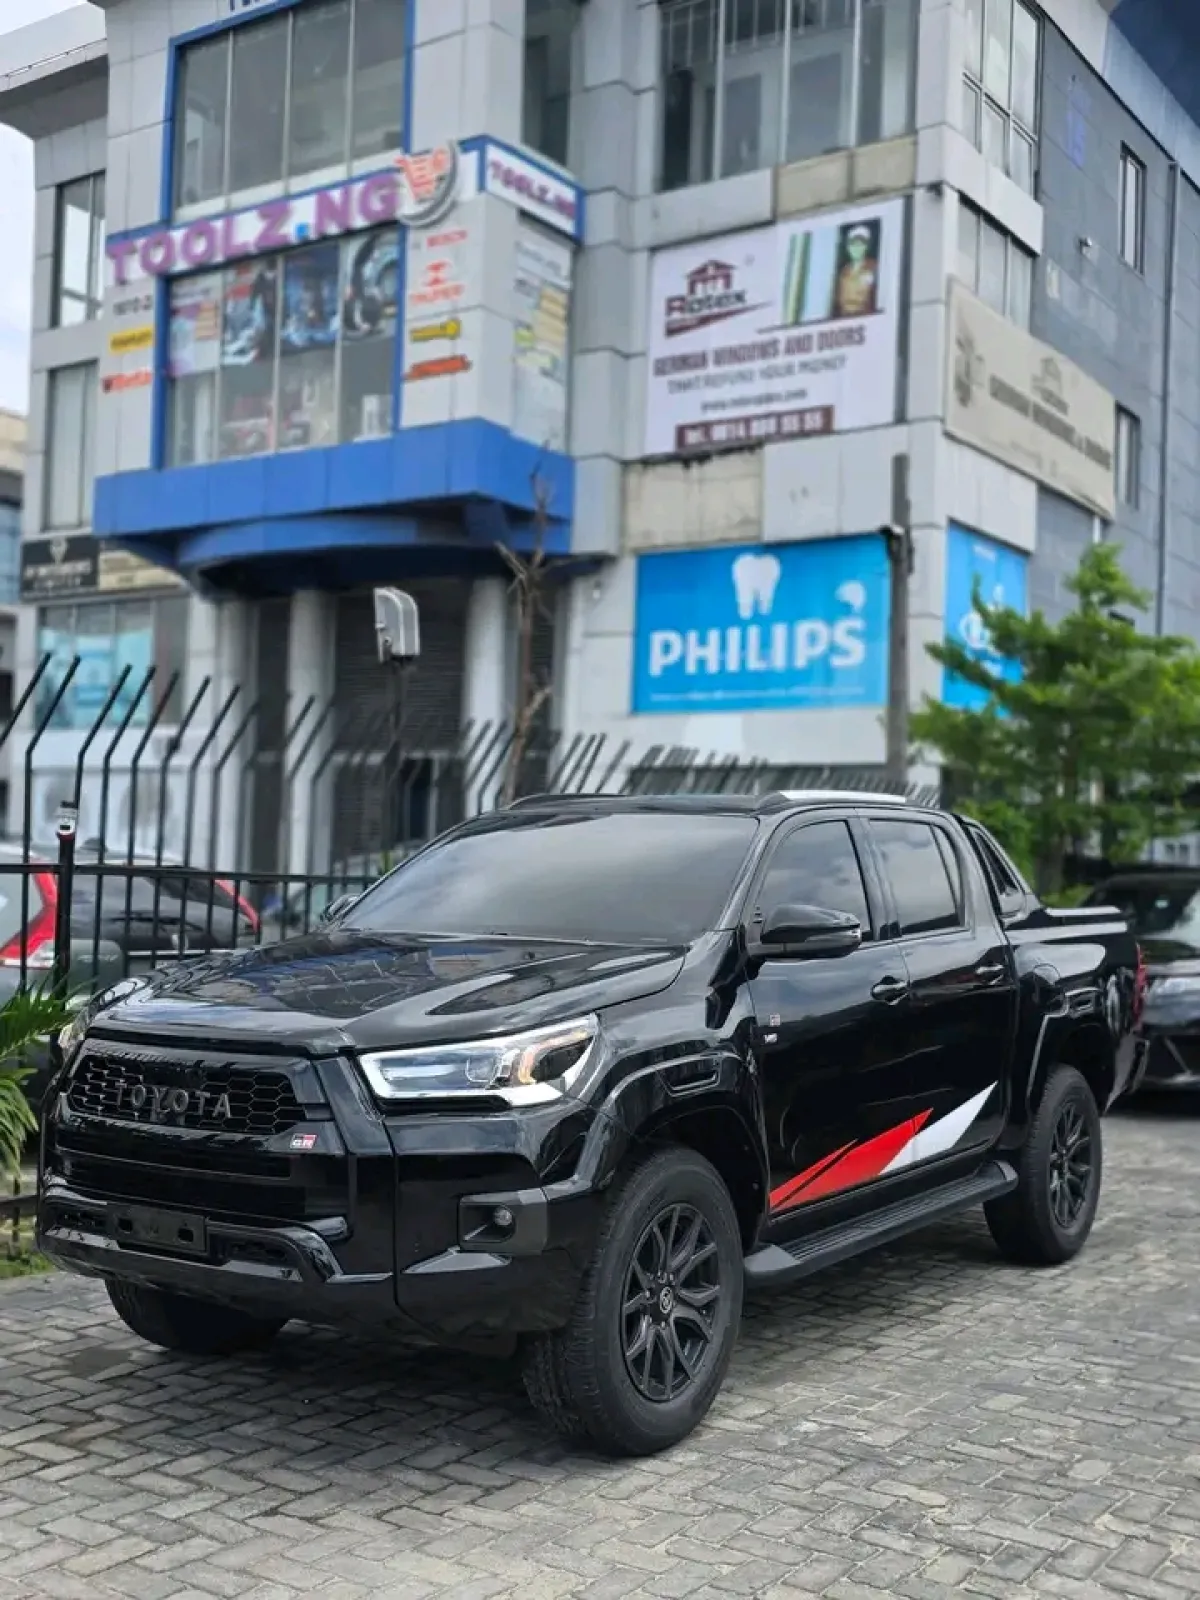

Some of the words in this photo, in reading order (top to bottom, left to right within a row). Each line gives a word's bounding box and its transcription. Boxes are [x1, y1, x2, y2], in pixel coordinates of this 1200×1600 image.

[106, 173, 399, 285] TOOLZ.NG
[712, 337, 781, 366] WINDOWS
[784, 332, 814, 354] AND
[817, 325, 866, 352] DOORS
[649, 616, 867, 677] PHILIPS
[116, 1080, 231, 1119] TOYOTA
